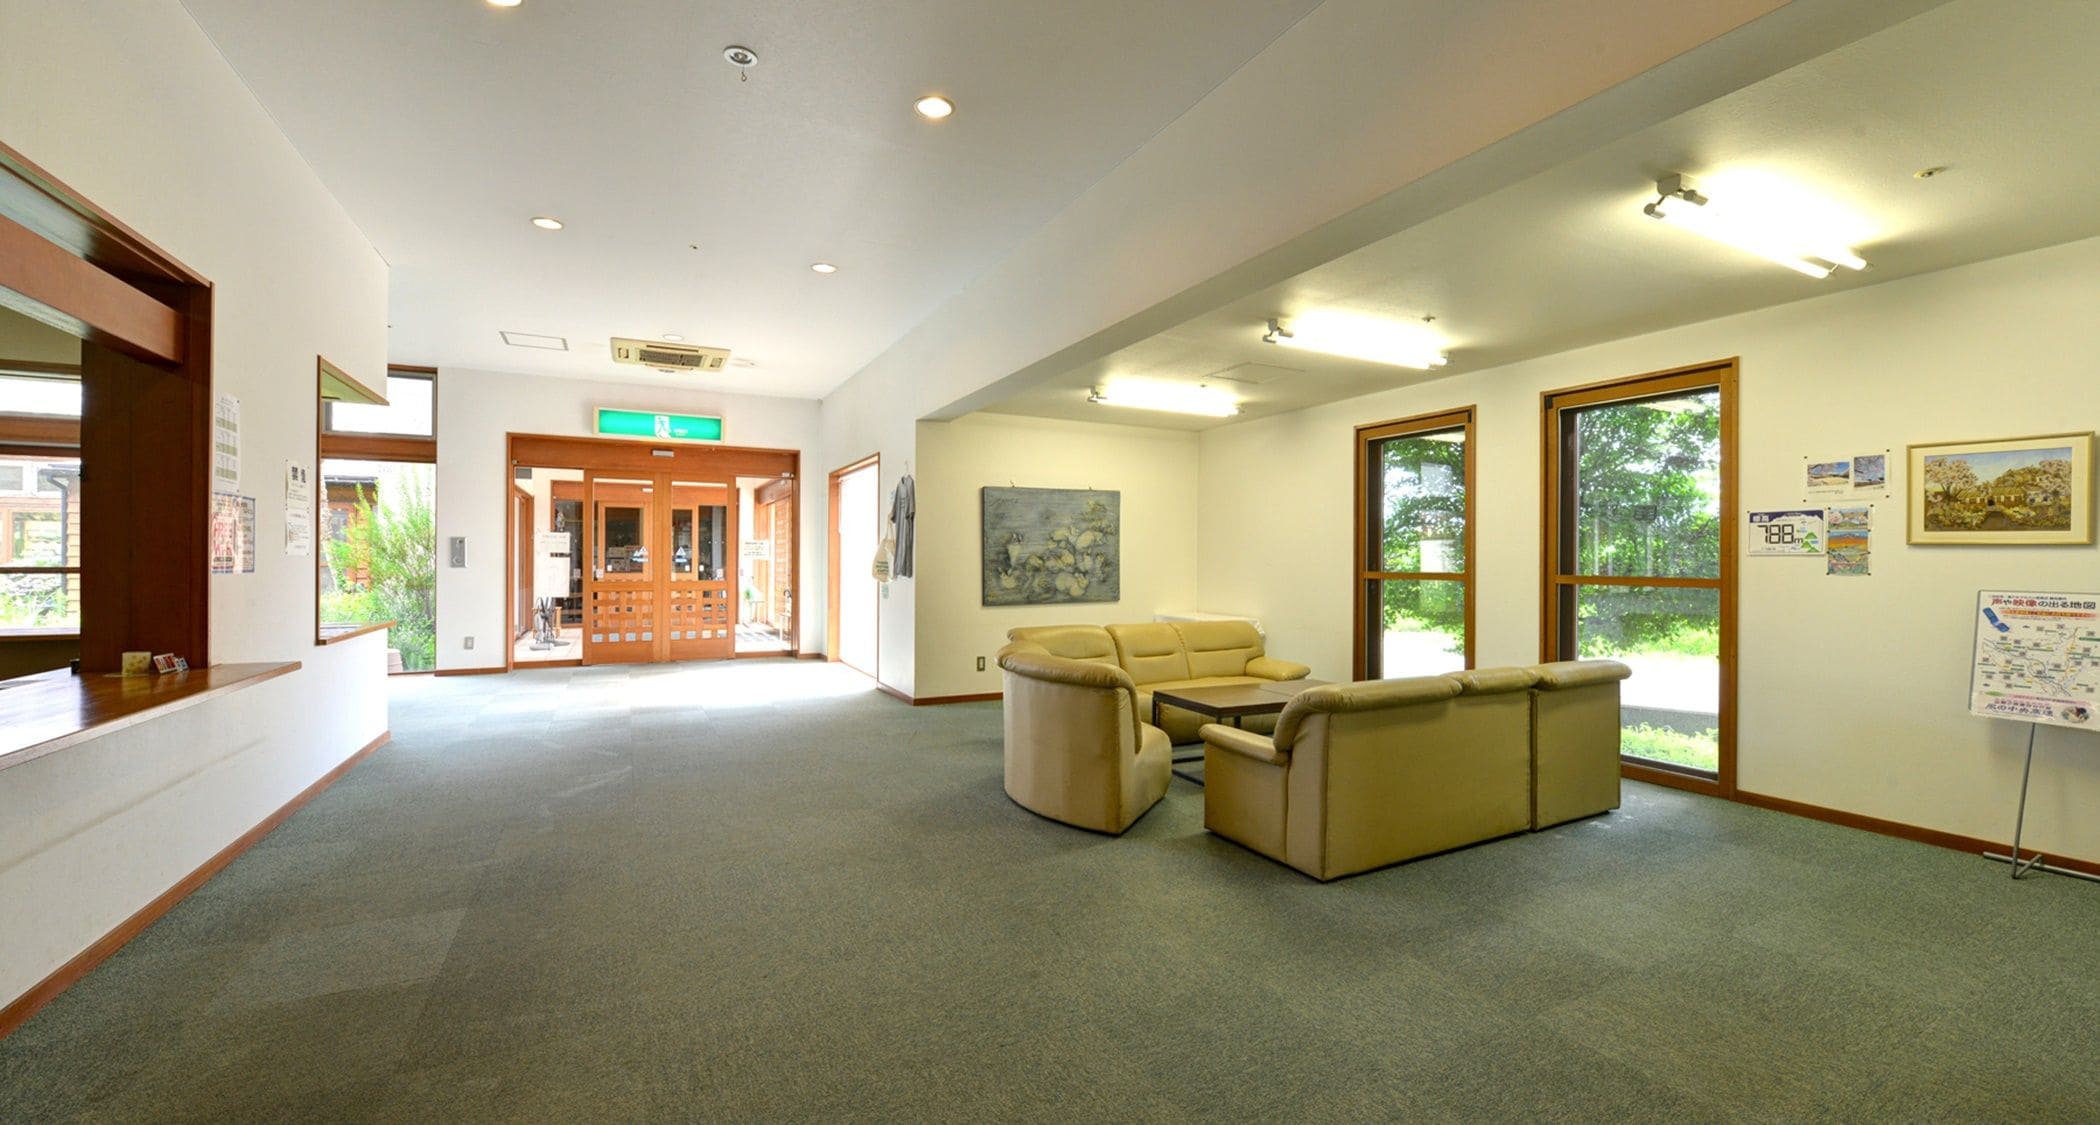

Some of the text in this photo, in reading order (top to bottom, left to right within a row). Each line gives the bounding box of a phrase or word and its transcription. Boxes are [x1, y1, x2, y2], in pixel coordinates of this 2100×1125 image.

[1990, 598, 2097, 610] 声や映像の出る地図
